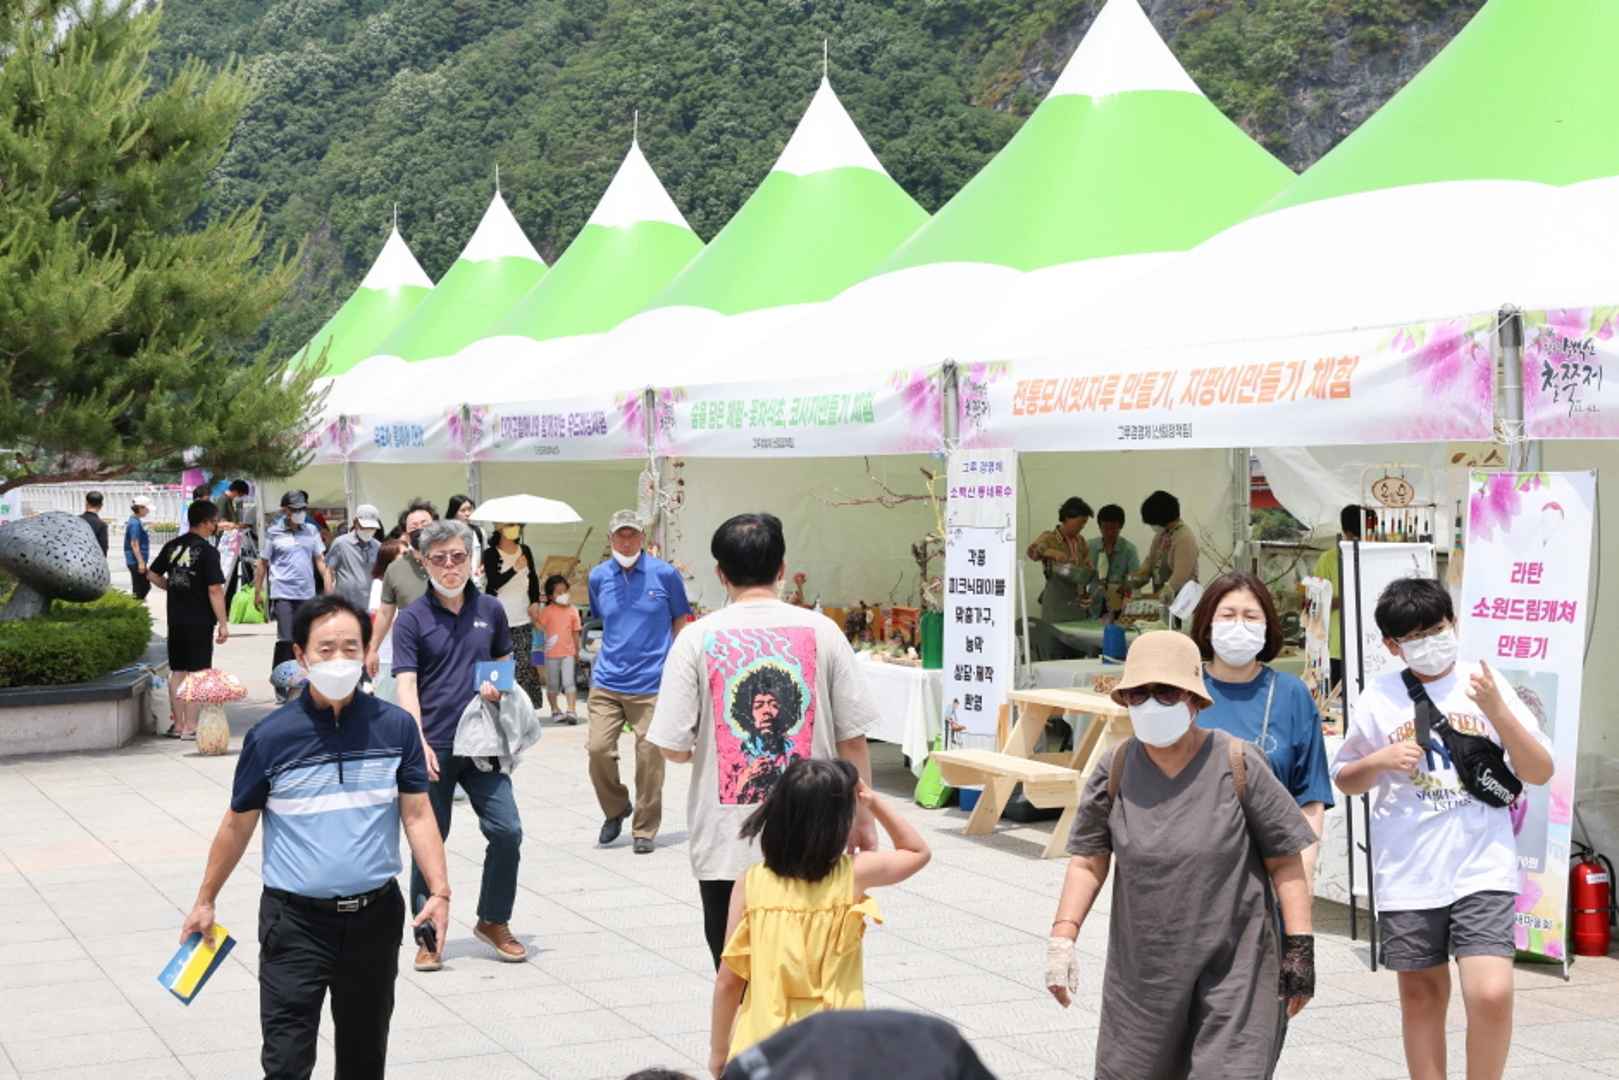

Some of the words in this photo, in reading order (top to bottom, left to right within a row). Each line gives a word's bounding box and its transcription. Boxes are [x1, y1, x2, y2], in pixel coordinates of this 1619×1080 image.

[1120, 369, 1178, 411] 만들기,
[1305, 355, 1360, 399] 체험
[967, 548, 986, 567] 각종
[1510, 561, 1544, 585] 라탄
[948, 577, 1006, 596] 피크닉테이블
[955, 606, 995, 627] 맞춤가구,
[1471, 596, 1578, 624] 소원드림캐쳐
[1497, 634, 1549, 660] 만들기
[964, 694, 983, 712] 환영
[1476, 767, 1515, 803] Supreme
